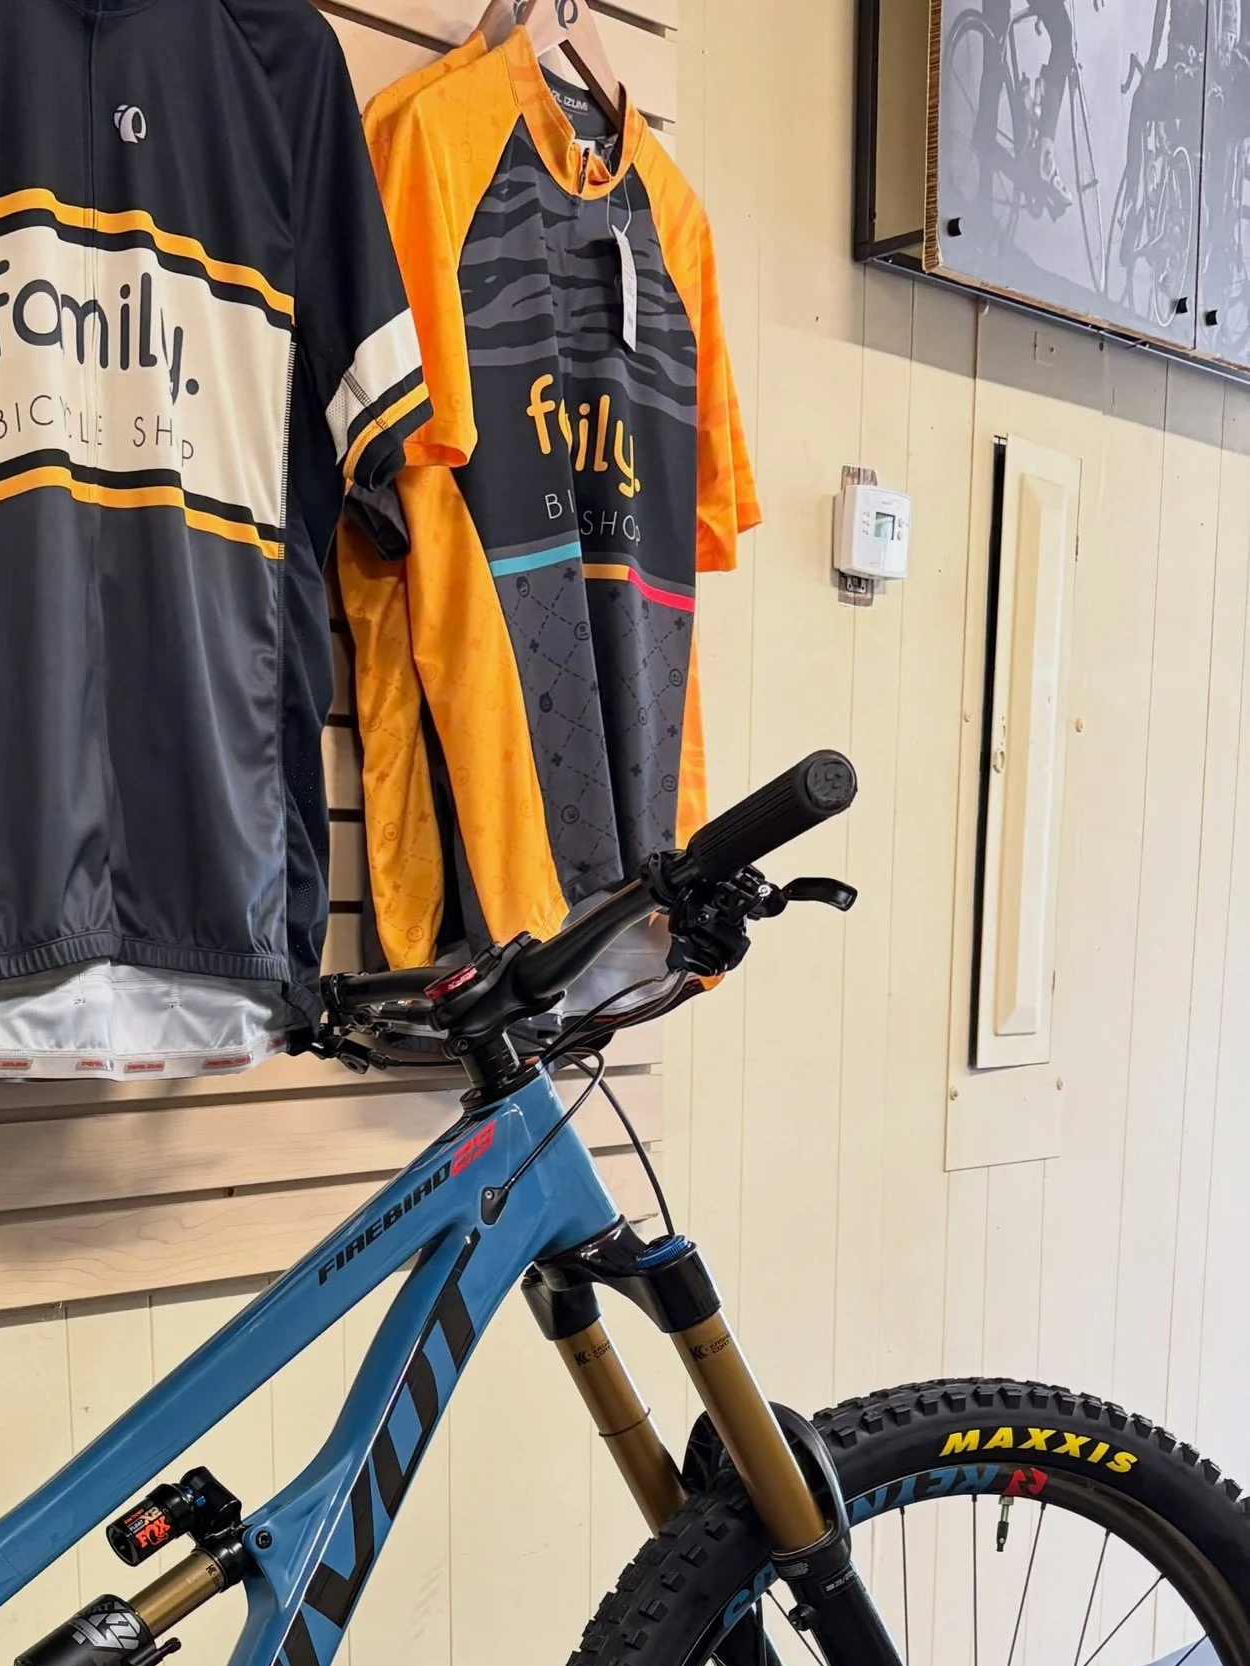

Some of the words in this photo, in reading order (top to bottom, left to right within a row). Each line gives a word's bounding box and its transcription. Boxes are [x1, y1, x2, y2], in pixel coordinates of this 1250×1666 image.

[132, 415, 195, 468] SHP
[526, 373, 641, 499] fily.
[318, 1160, 452, 1287] FIREBIRD
[450, 1119, 496, 1178] 29
[938, 1427, 1140, 1475] MAXXIS
[135, 1515, 171, 1548] FOX
